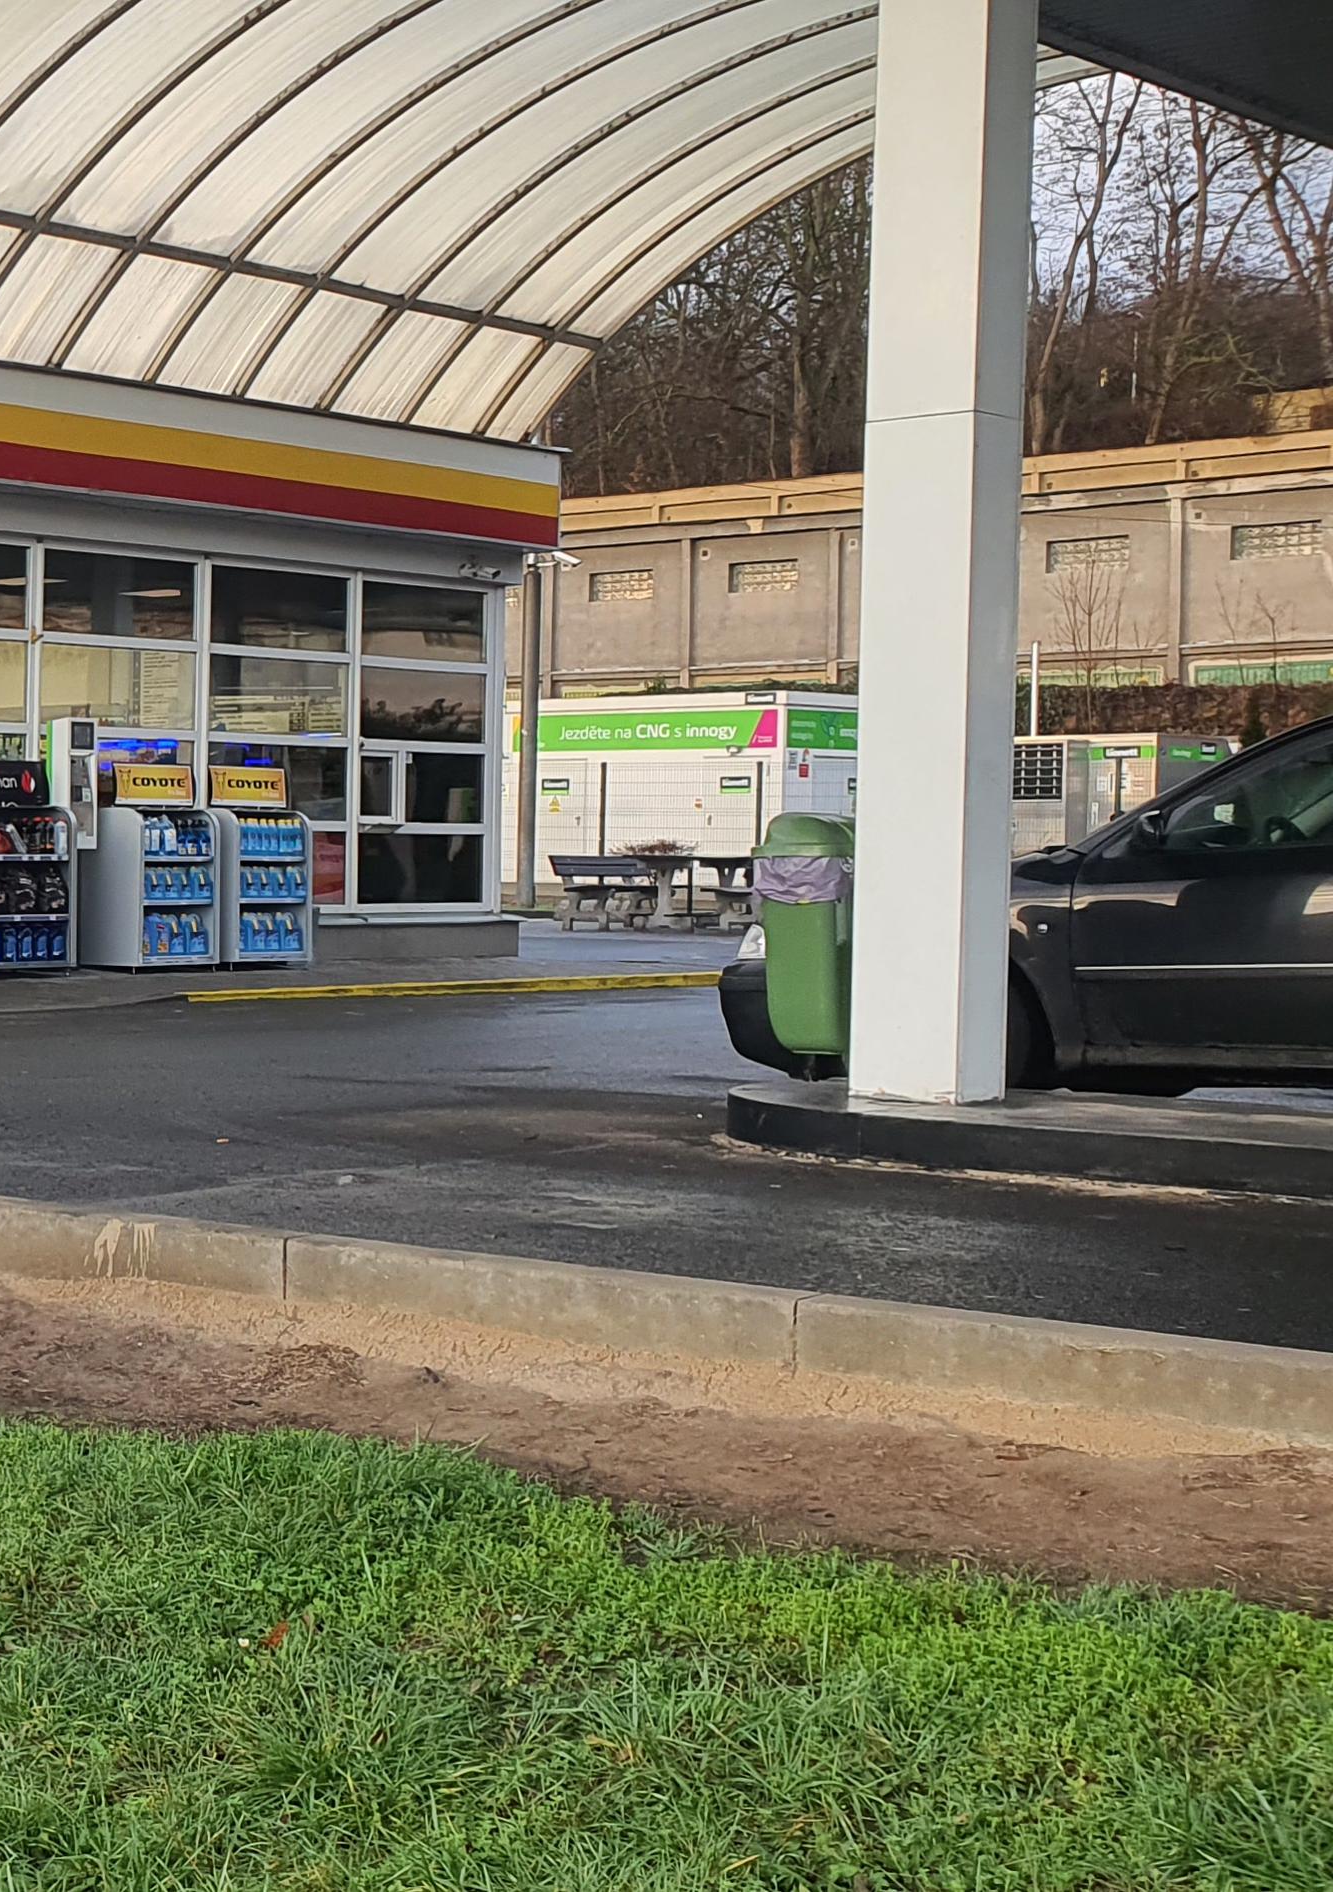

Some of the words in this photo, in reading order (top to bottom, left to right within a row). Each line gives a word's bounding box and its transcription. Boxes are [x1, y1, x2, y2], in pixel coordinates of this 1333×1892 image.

[559, 725, 611, 740] Jezděte
[614, 730, 632, 739] na
[636, 723, 670, 739] CNG
[674, 727, 682, 738] s
[685, 723, 737, 741] innogy
[132, 776, 186, 788] COYOTE
[227, 778, 280, 790] COYOTE
